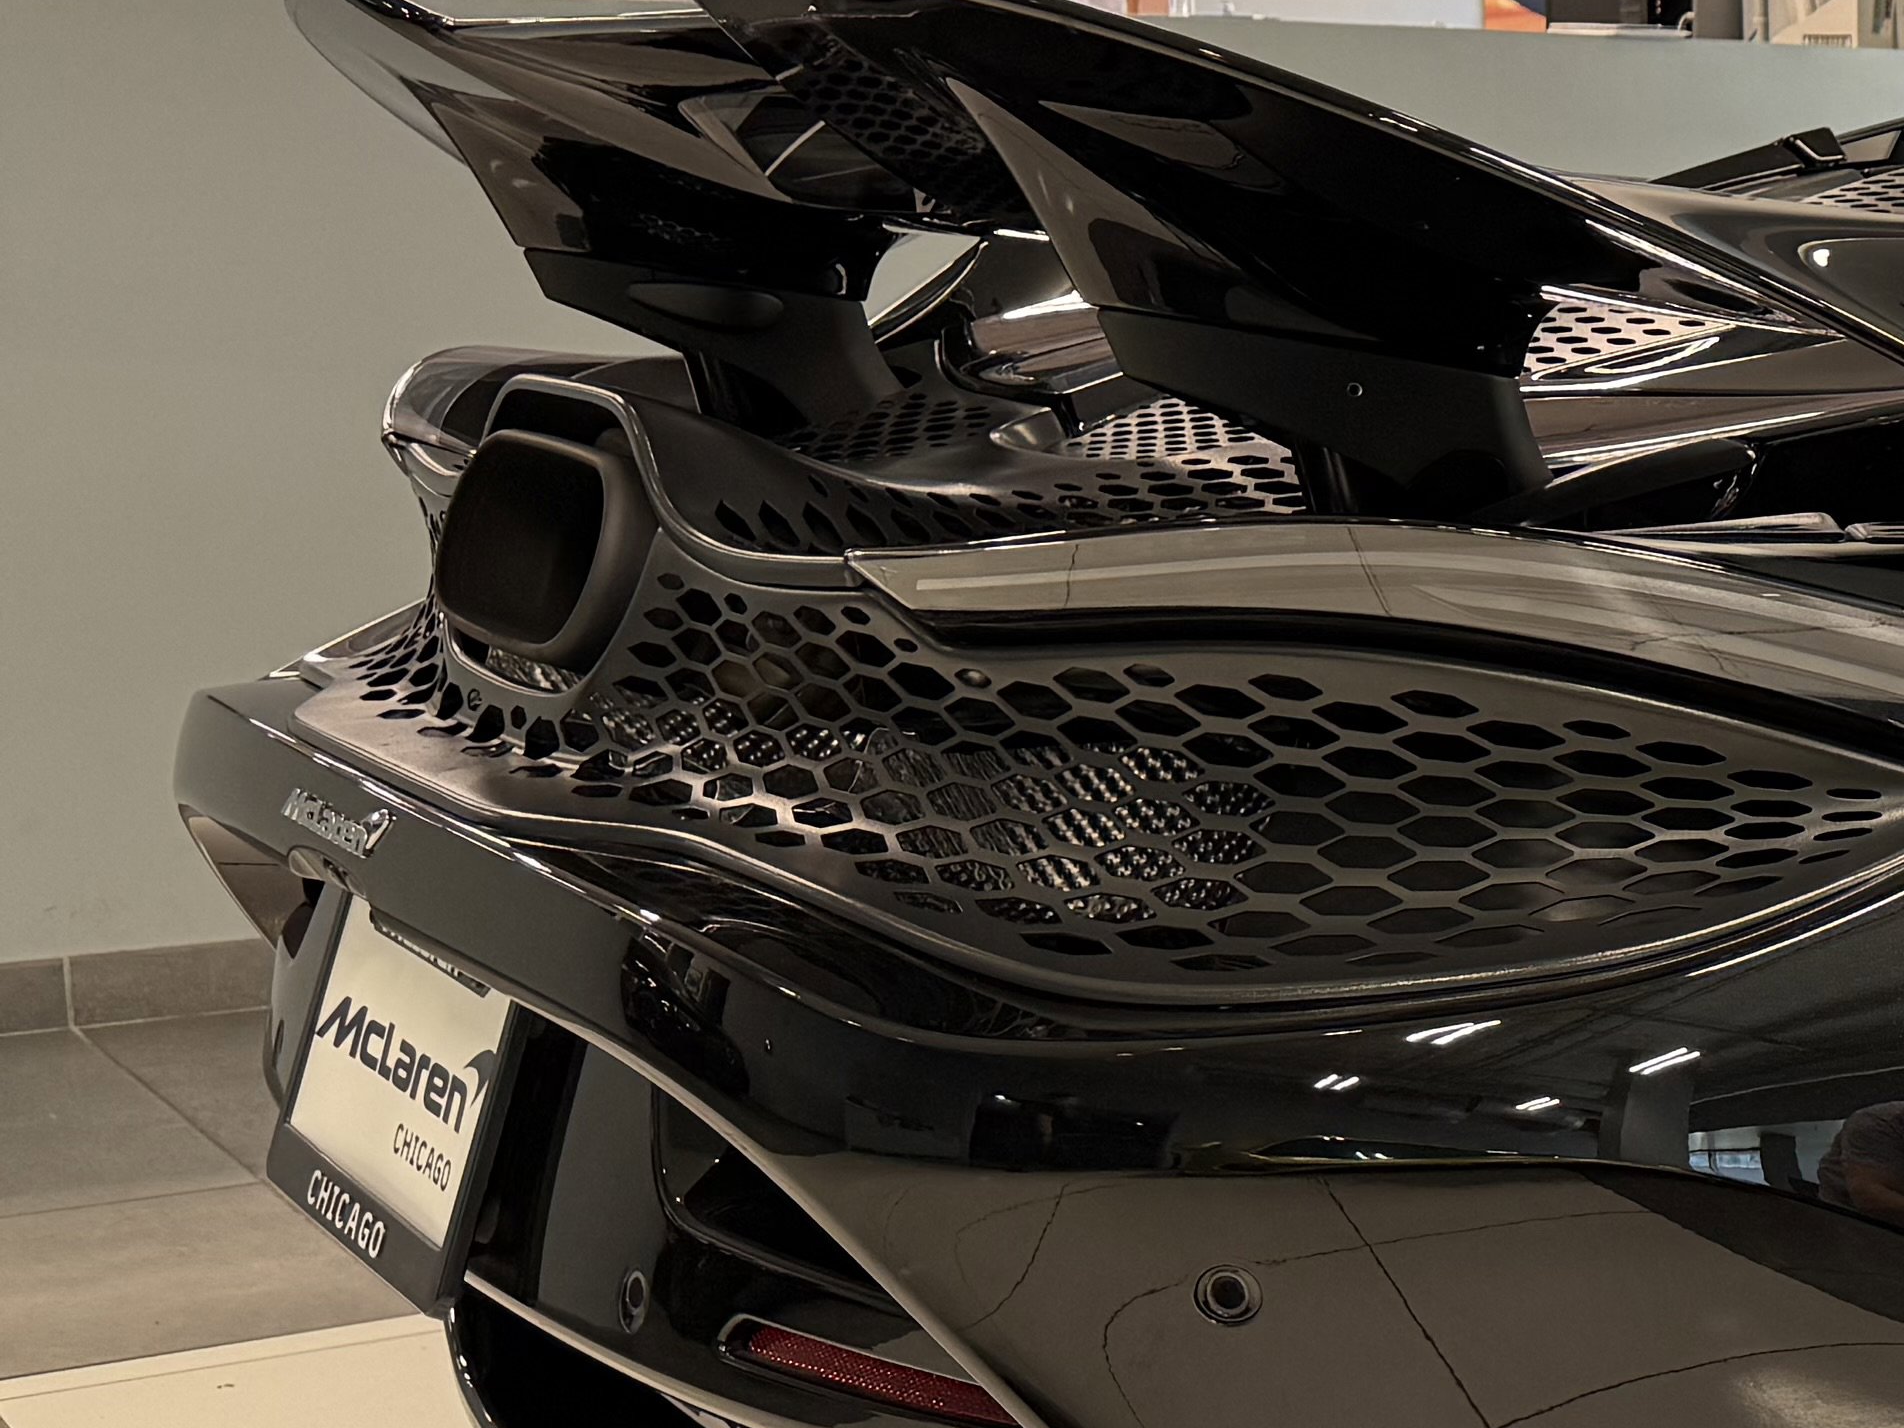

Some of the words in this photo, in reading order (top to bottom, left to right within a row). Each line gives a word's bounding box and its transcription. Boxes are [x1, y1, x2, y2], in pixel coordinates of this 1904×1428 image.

[281, 788, 368, 860] McLaren
[314, 995, 469, 1134] McLaren
[393, 1123, 452, 1192] CHICAGO
[306, 1169, 386, 1259] CHICAGO
